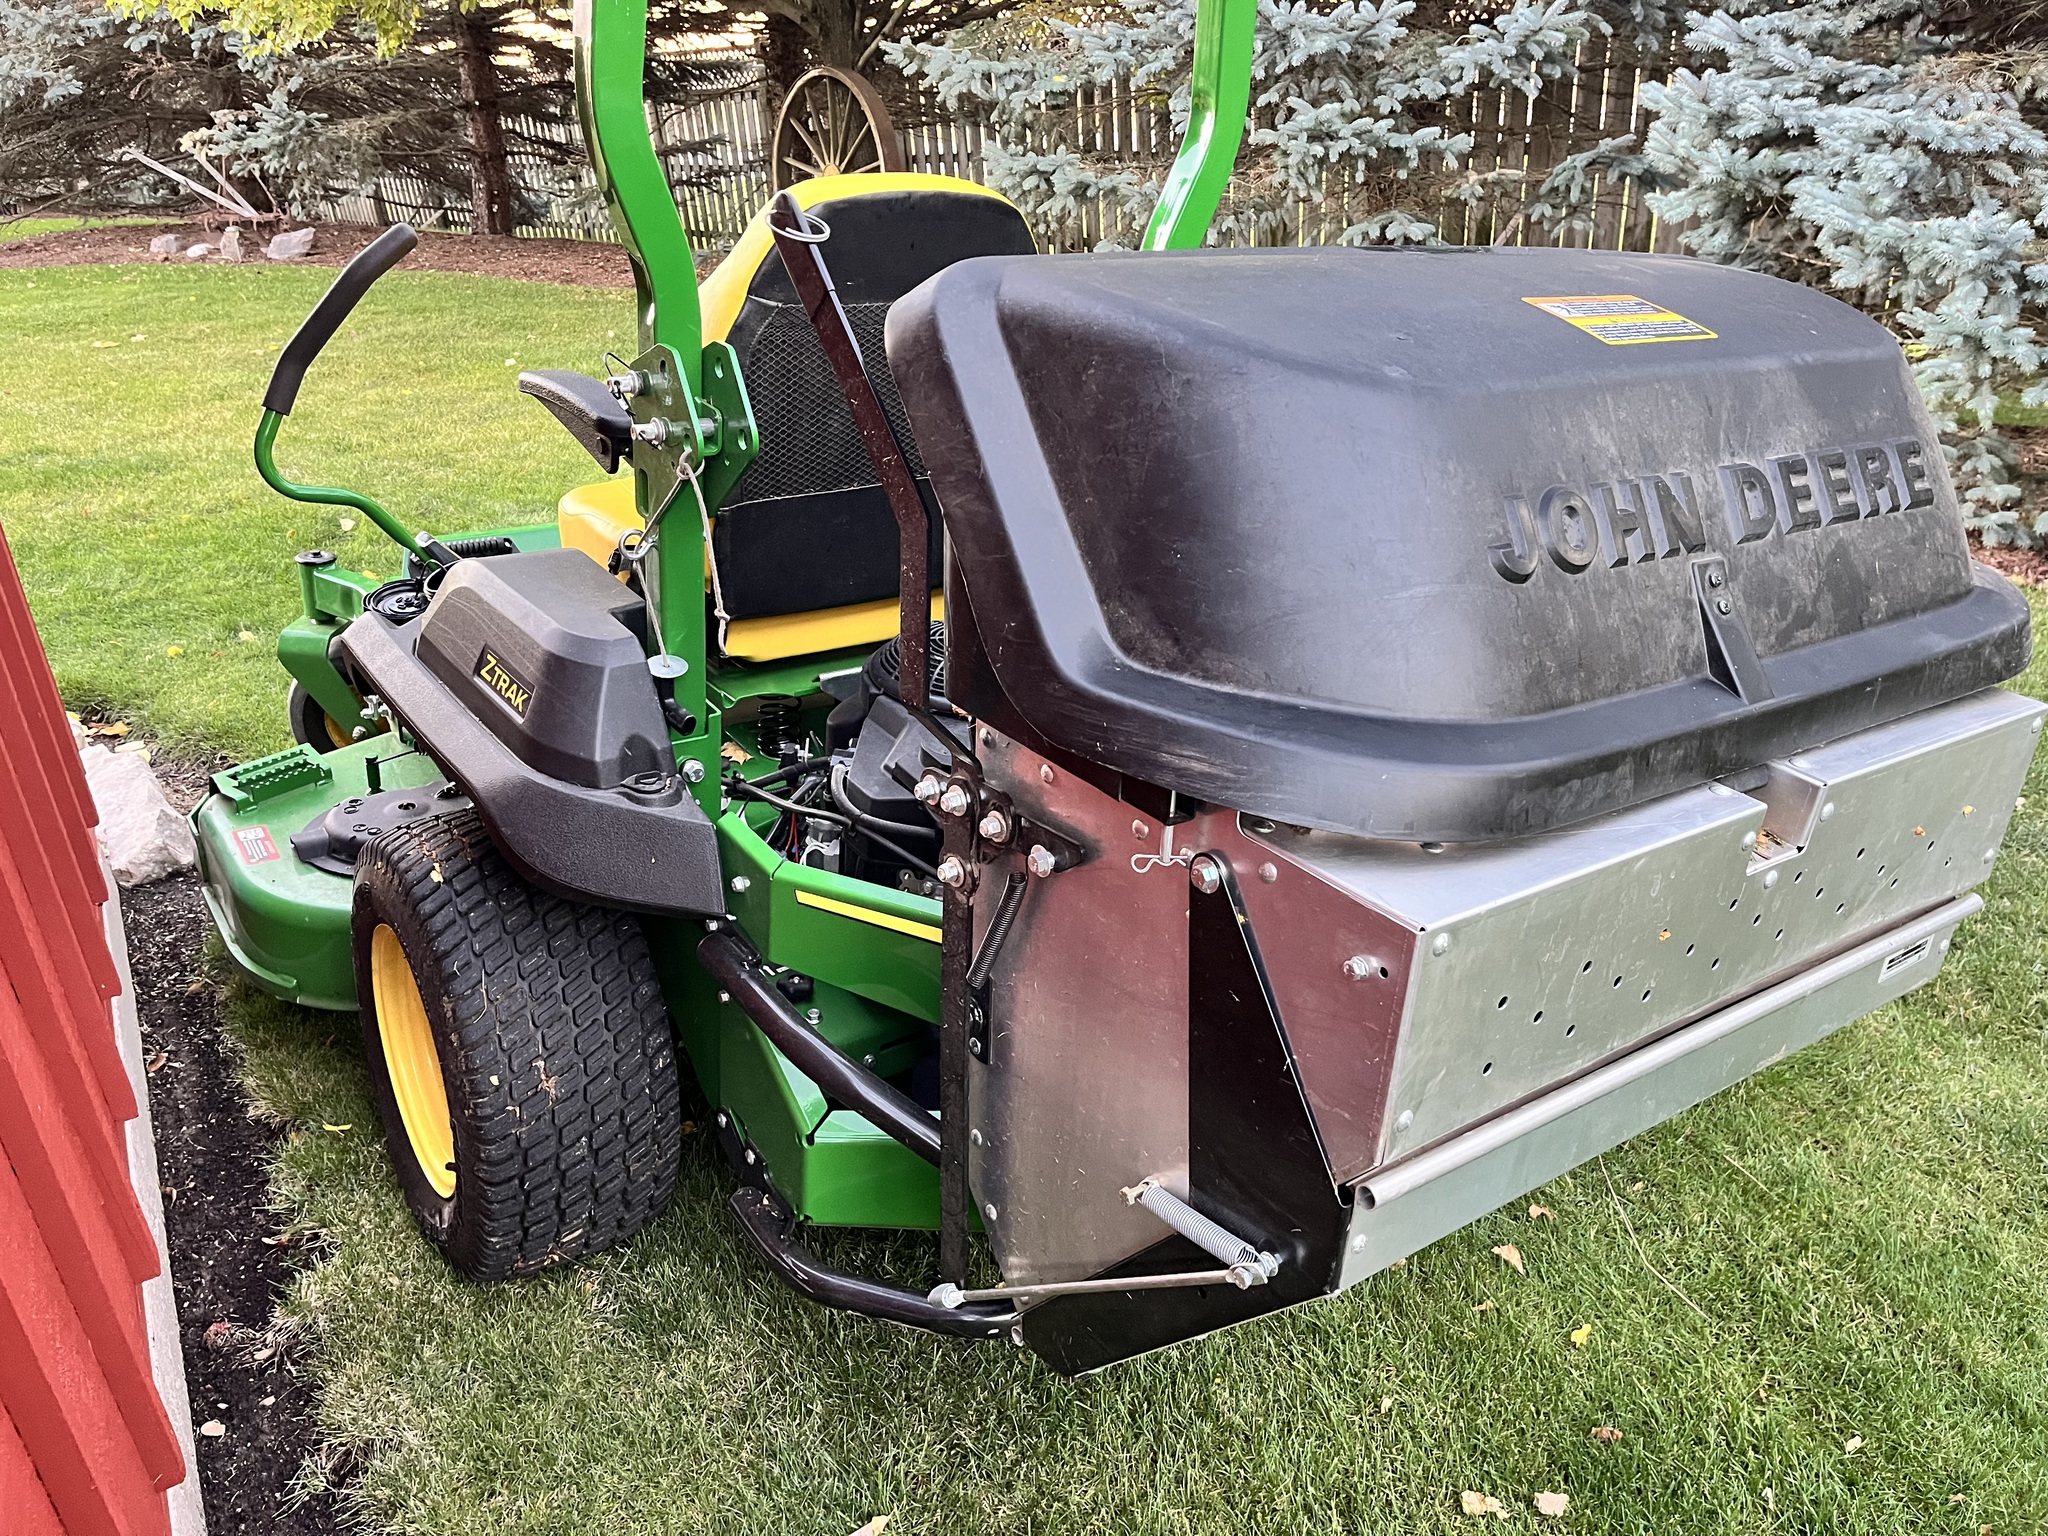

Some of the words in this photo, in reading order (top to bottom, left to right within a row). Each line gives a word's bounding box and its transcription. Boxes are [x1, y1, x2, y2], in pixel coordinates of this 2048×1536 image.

[1488, 471, 1706, 584] JOHN
[1719, 439, 1934, 545] DEERE
[480, 653, 528, 712] ZTRAK
